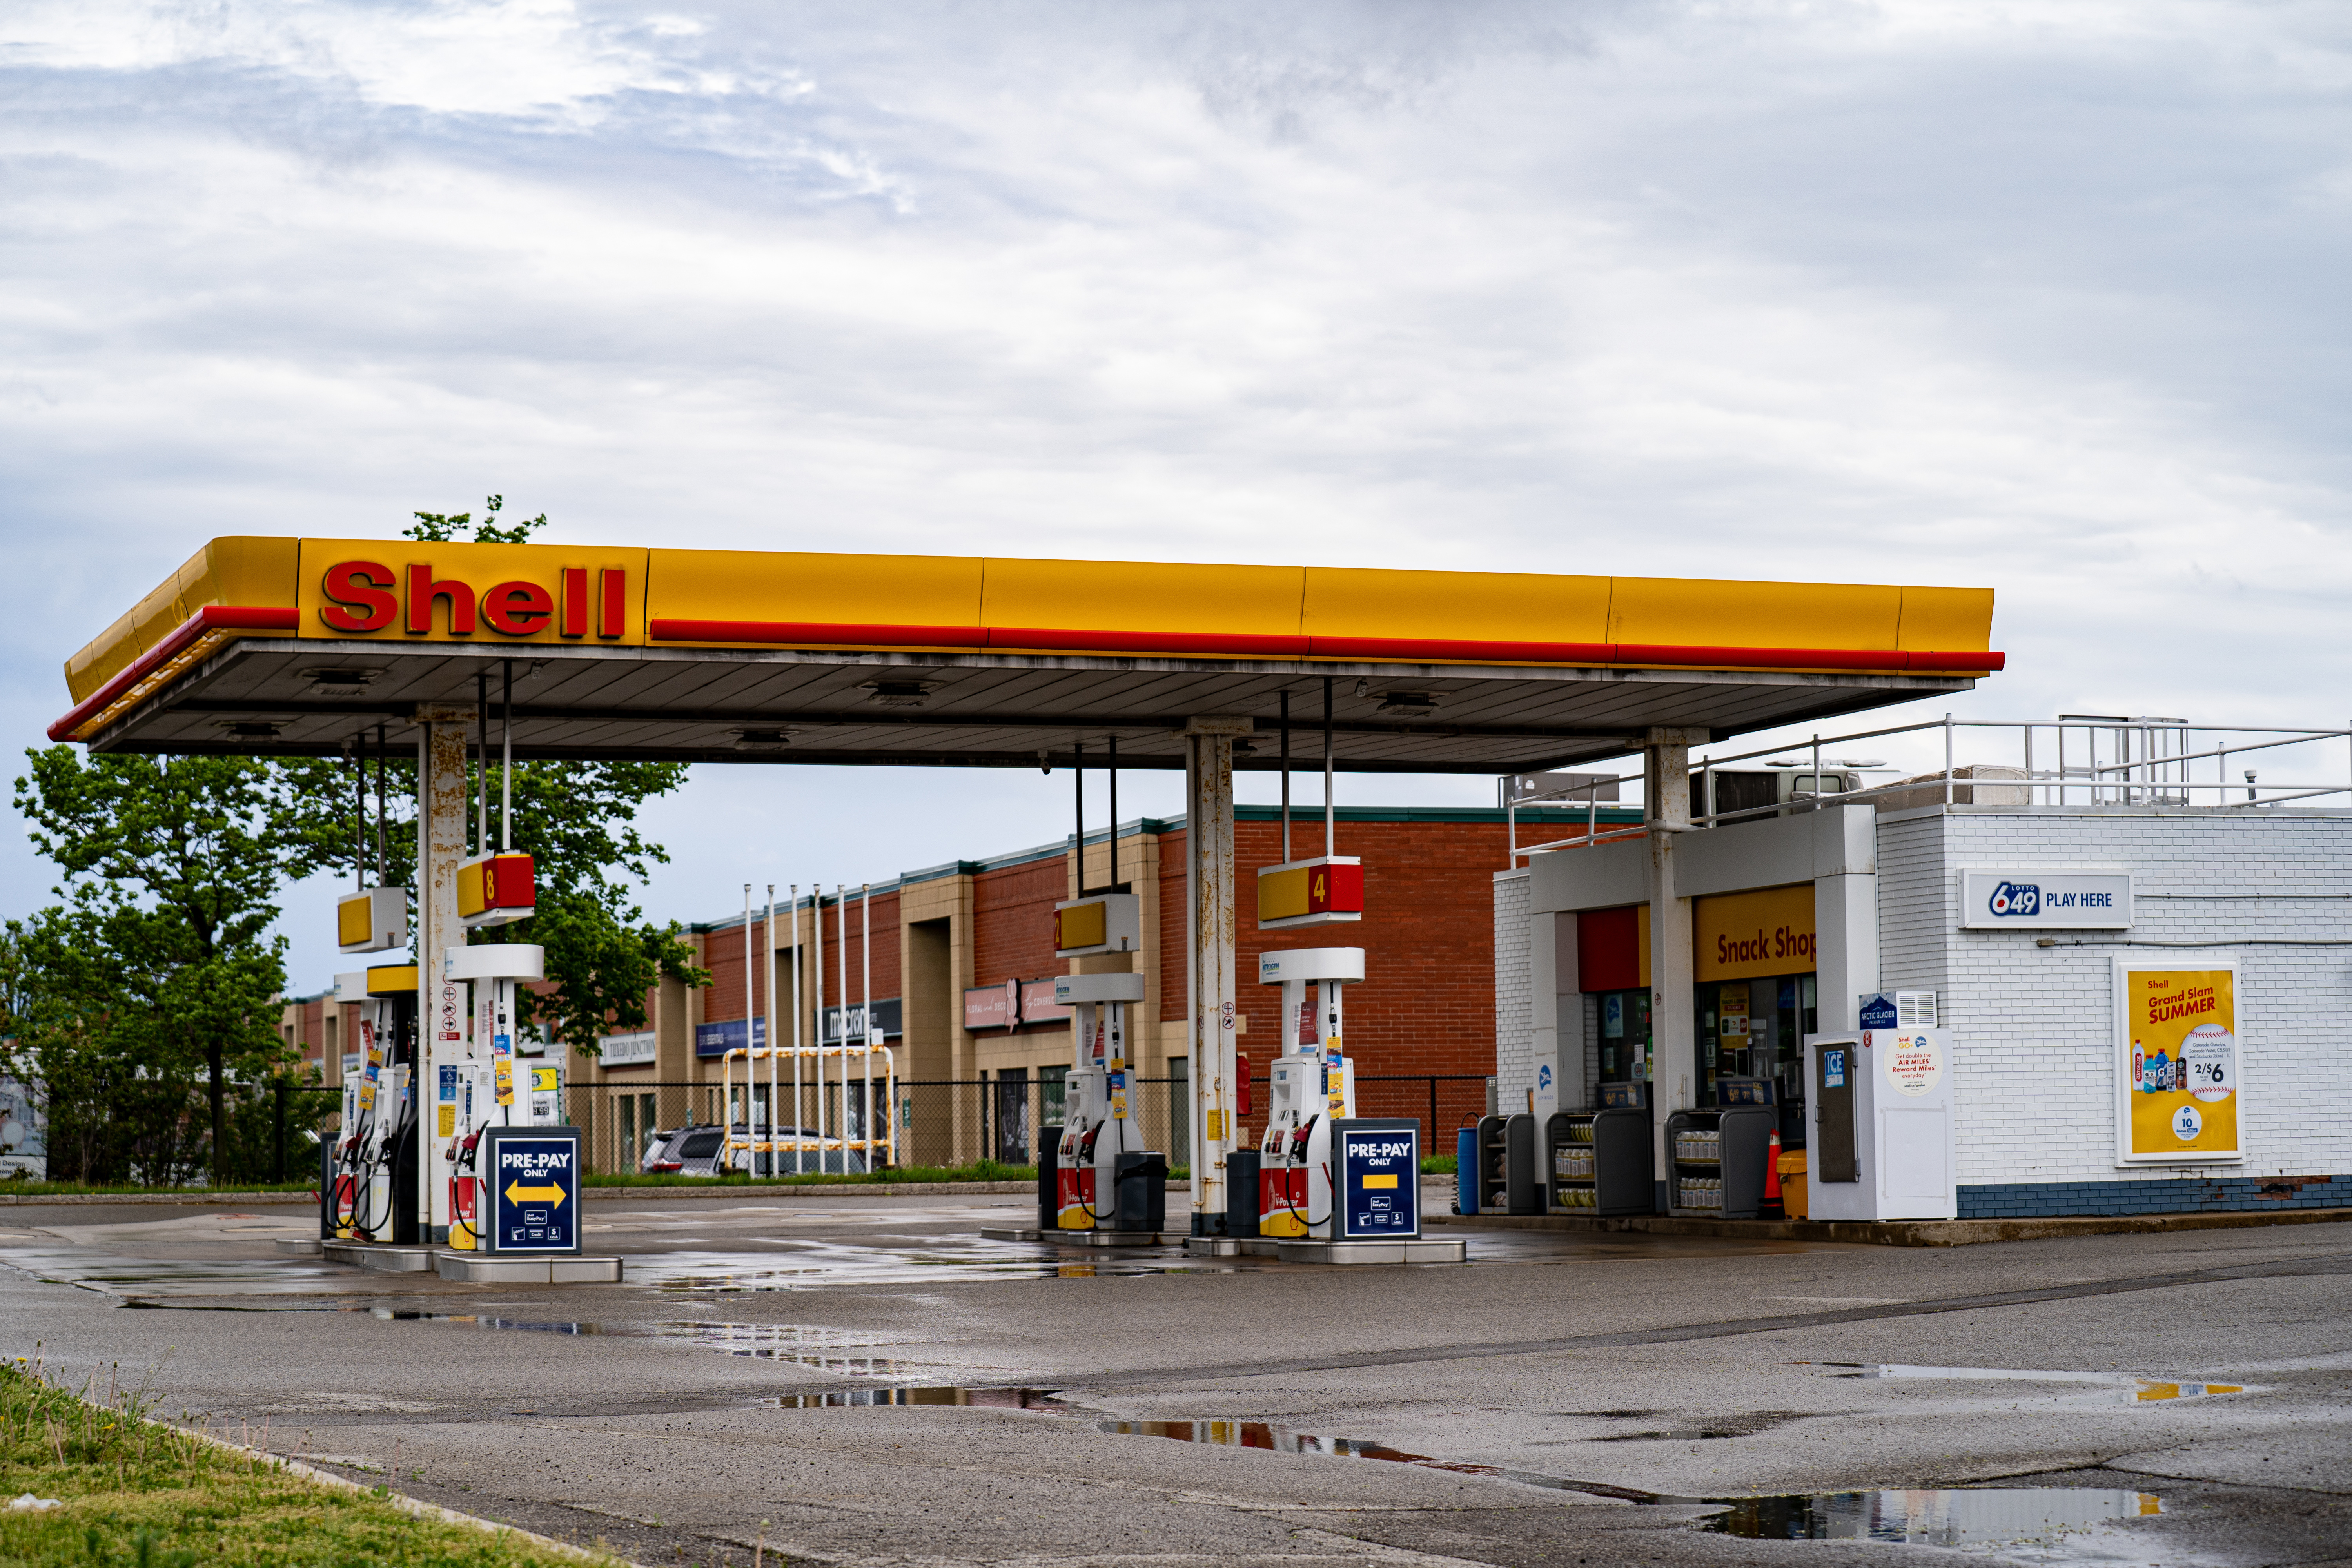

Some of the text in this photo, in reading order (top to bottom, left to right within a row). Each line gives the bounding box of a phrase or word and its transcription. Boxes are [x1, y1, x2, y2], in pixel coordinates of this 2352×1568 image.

[319, 561, 626, 638] Shell
[486, 869, 495, 900] 8
[1314, 873, 1326, 902] 4
[1992, 885, 2037, 914] 649
[2046, 893, 2112, 907] PLAY HERE
[1055, 918, 1060, 943] 2
[1718, 925, 1816, 964] Snack Shop
[2148, 980, 2169, 989] Shell
[2149, 987, 2213, 1008] Grand Slam
[1861, 1010, 1895, 1020] ARCTIC GLACIER
[2149, 996, 2216, 1024] SUMMER
[1827, 1054, 1842, 1073] ICE
[2158, 1067, 2165, 1076] G
[2182, 1118, 2192, 1128] 10
[1349, 1143, 1410, 1157] PRE-PAY
[3, 1160, 25, 1168] Design
[502, 1153, 571, 1167] PRE-PAY
